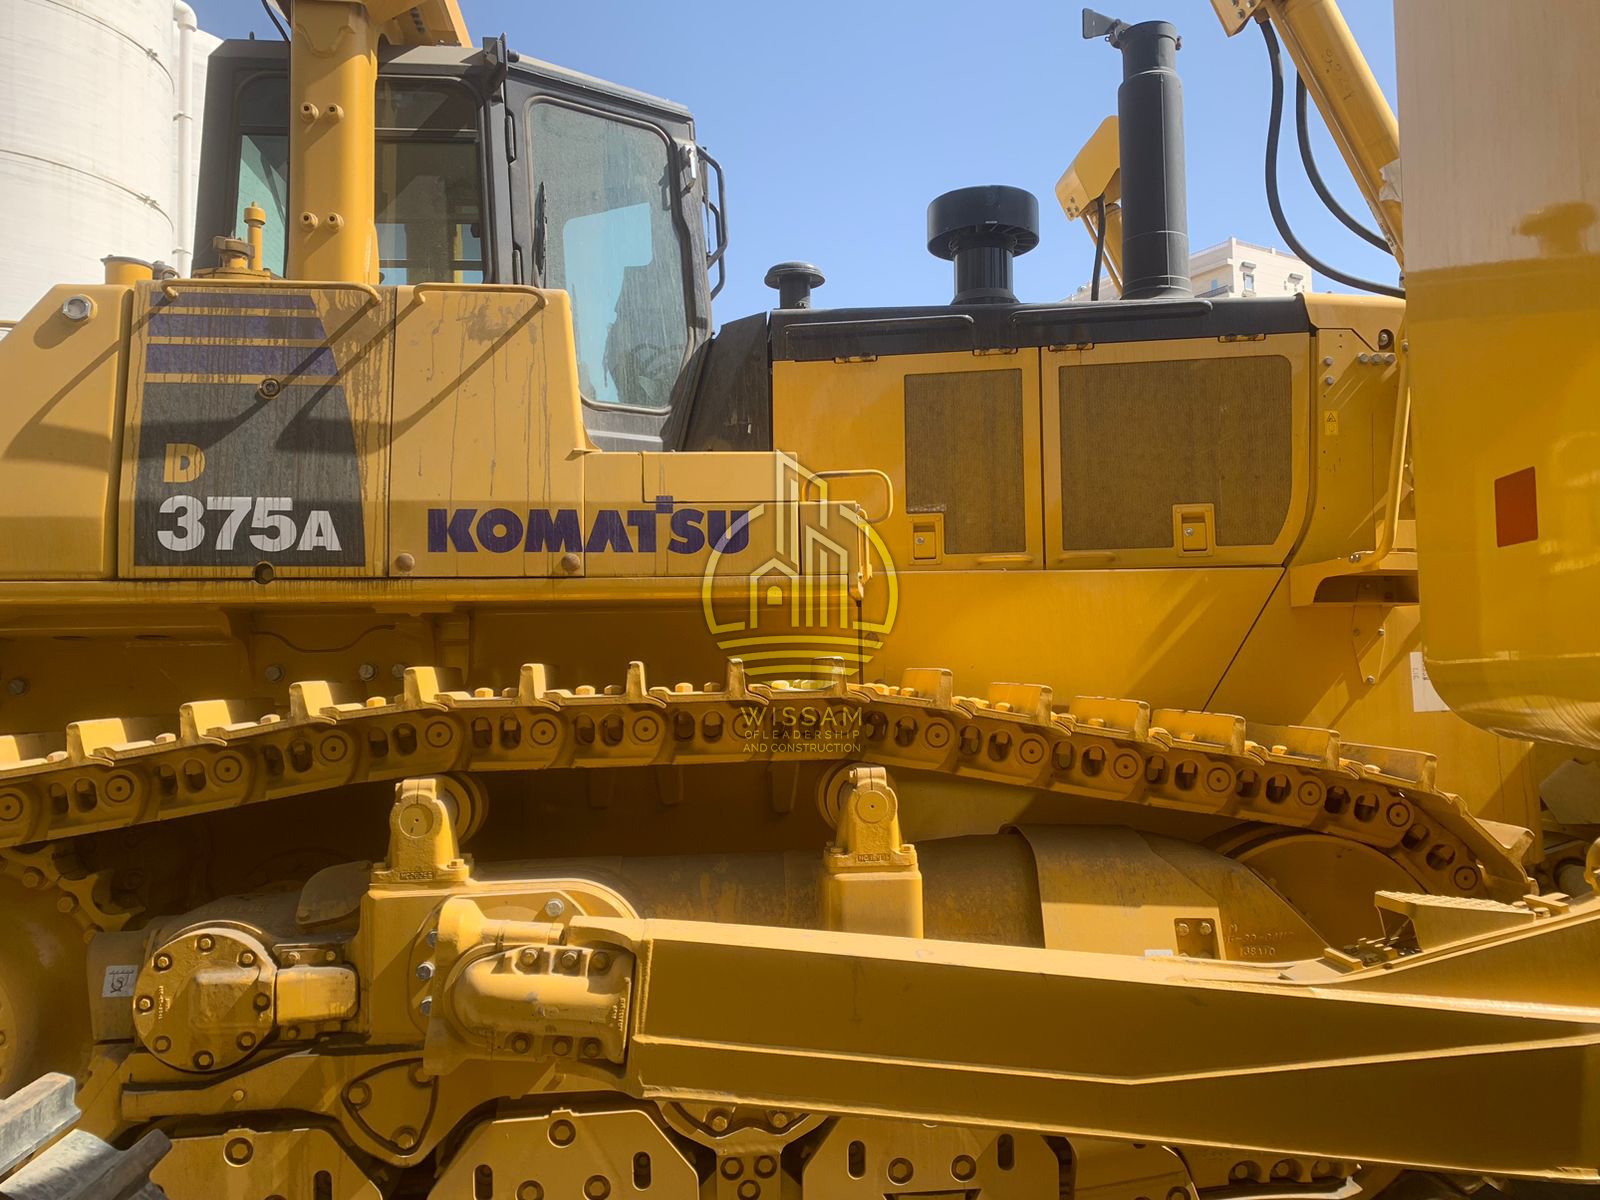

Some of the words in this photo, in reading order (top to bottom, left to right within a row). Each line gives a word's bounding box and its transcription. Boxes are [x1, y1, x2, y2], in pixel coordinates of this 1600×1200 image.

[164, 444, 205, 483] D
[157, 495, 342, 552] 375A
[428, 495, 750, 553] KOMATSU
